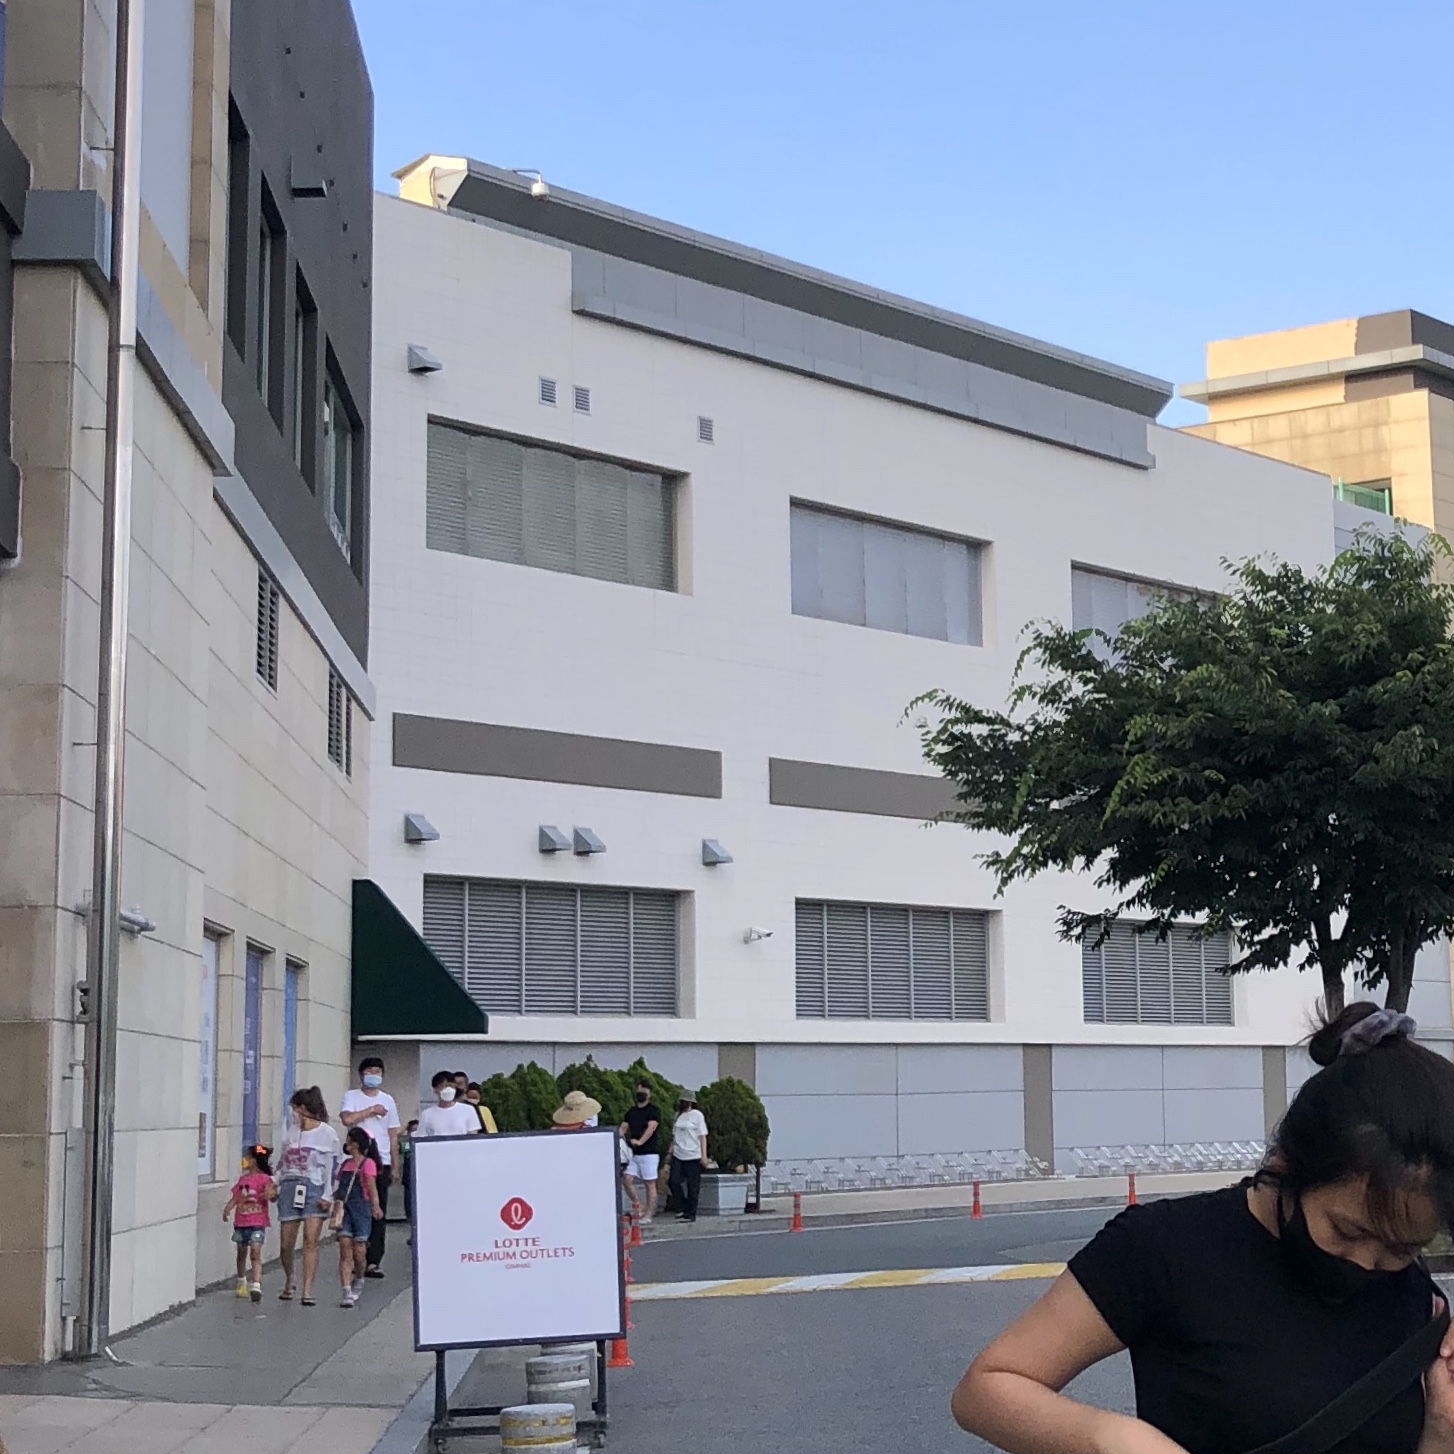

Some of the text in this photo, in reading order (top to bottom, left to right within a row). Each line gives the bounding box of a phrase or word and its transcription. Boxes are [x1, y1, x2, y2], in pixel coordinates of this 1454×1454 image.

[494, 1236, 541, 1249] LOTTE
[460, 1246, 576, 1263] PREMIUM OUTLETS
